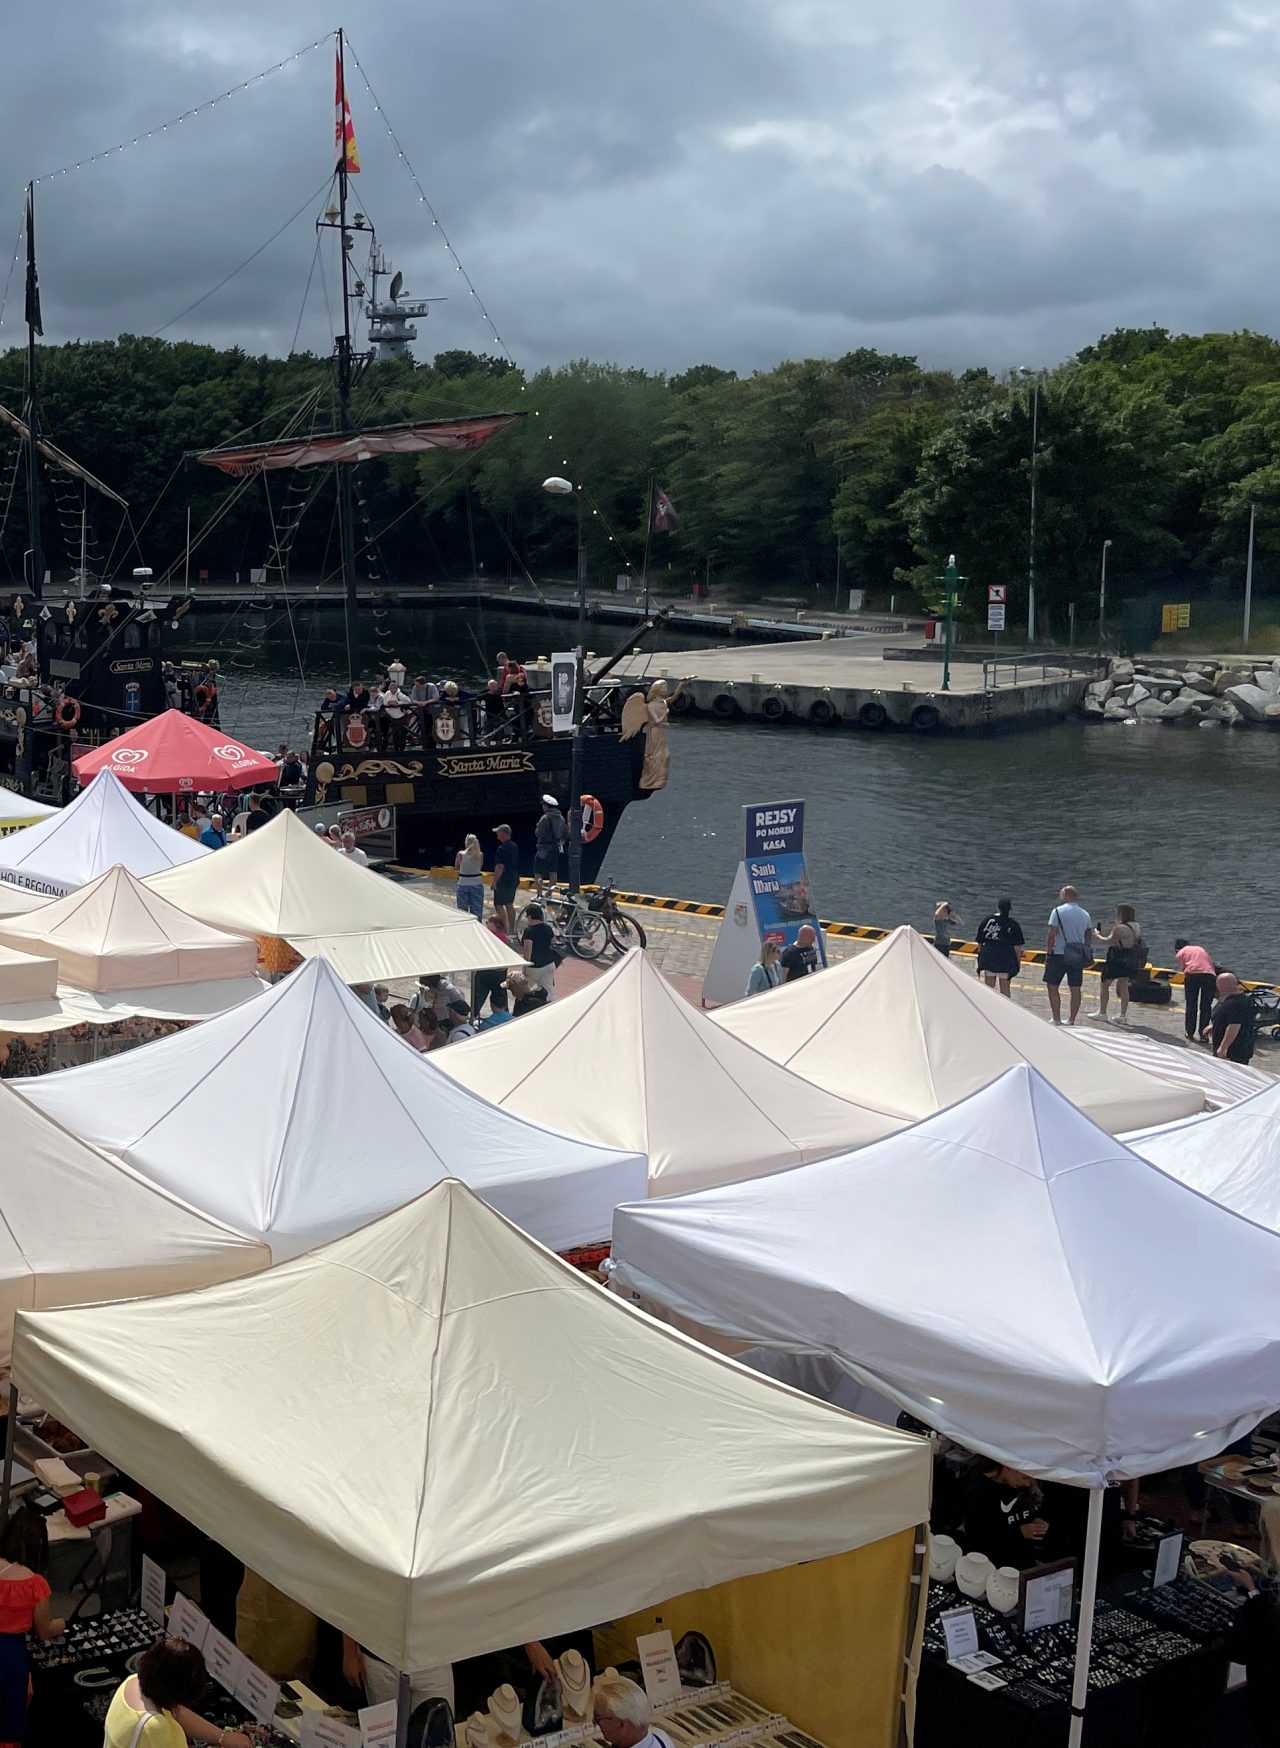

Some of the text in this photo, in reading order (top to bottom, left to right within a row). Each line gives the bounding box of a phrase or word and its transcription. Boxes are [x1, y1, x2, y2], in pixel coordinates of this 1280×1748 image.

[449, 756, 521, 774] Santa Maria
[755, 808, 797, 827] REJSY
[755, 826, 794, 838] PO MORZU
[763, 839, 786, 851] KASA
[751, 863, 776, 877] Santa
[753, 880, 779, 894] Maria
